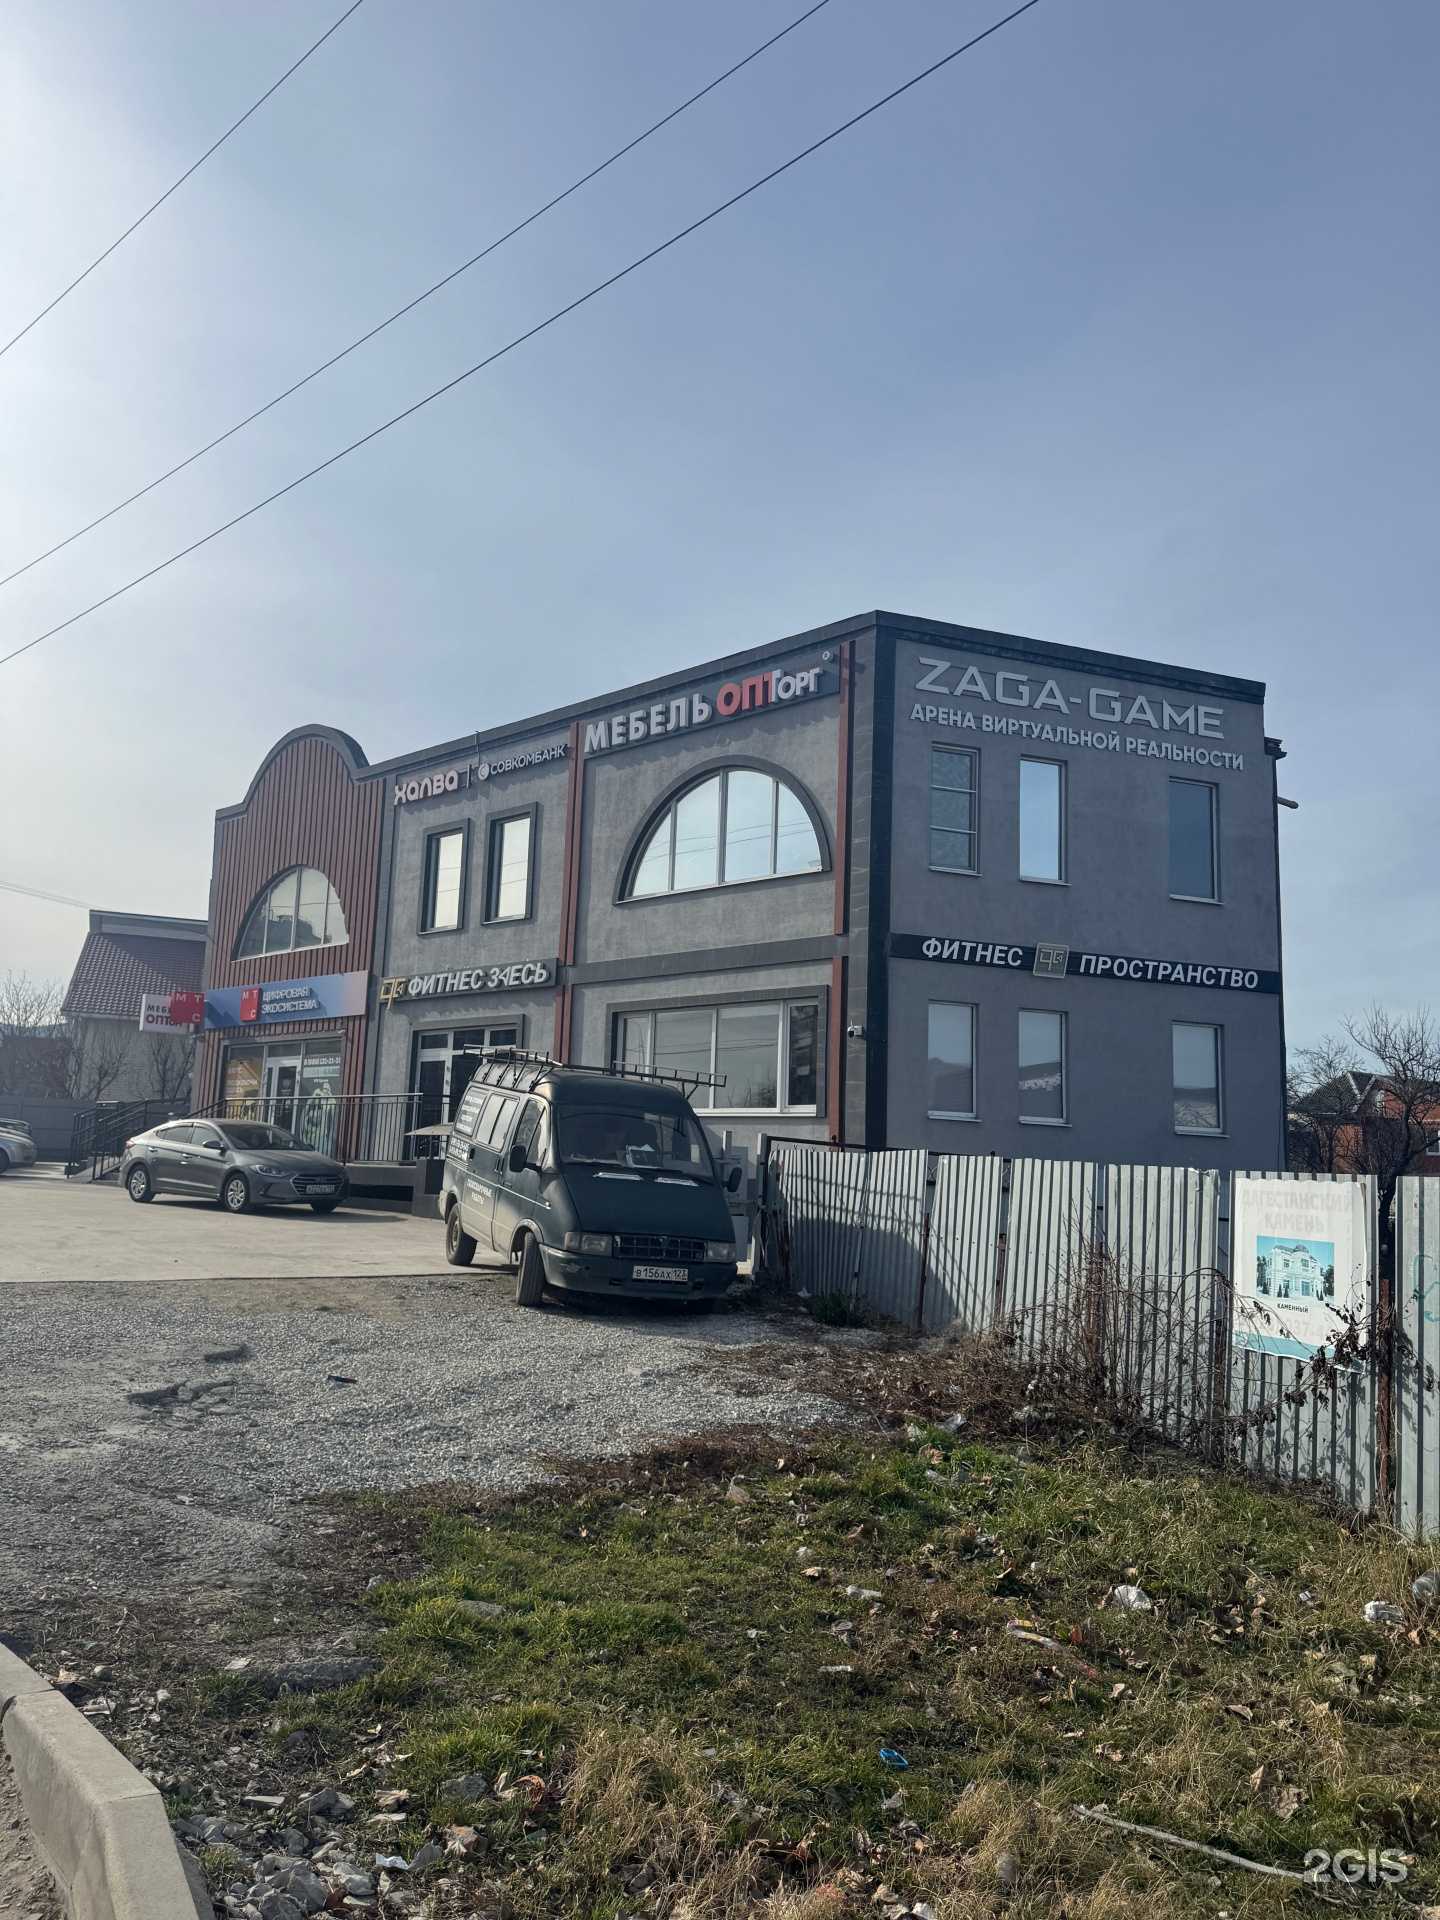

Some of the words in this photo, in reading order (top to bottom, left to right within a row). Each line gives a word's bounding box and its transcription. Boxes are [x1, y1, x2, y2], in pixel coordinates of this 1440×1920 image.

[584, 693, 714, 754] МЕБЕЛЬ
[914, 656, 1225, 739] ZAGA-GAME
[490, 744, 567, 775] СОВКОМБАНК
[910, 703, 977, 730] АРЕНА
[982, 714, 1121, 752] ВИРТУАЛЬНОЙ
[1126, 737, 1244, 771] РЕАЛЬНОСТИ
[408, 969, 483, 996] ФИТНЕС
[922, 937, 1023, 967] ФИТНЕС
[1079, 954, 1259, 989] ПРОСТРАНСТВО
[261, 1000, 318, 1014] ЭКОСИСТЕМА
